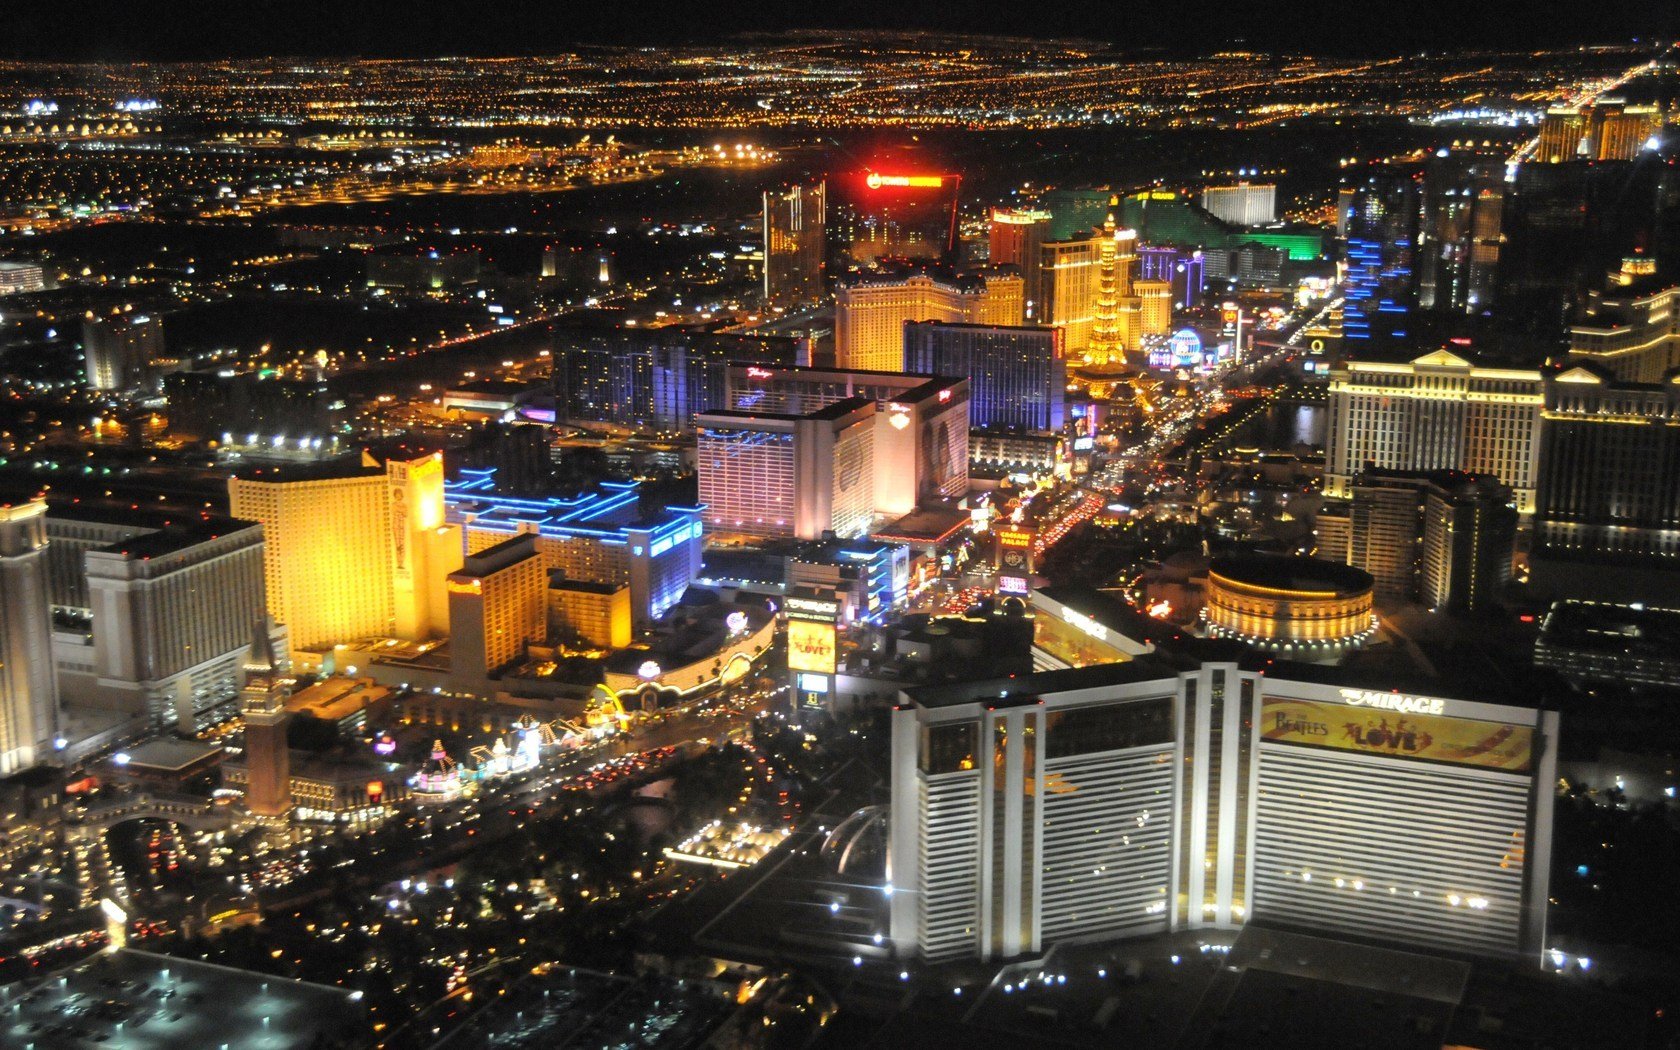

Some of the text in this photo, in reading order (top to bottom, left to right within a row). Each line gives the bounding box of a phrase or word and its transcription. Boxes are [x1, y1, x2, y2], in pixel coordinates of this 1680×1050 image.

[1001, 539, 1029, 547] PALACE
[800, 645, 824, 656] LOVE
[1358, 690, 1444, 715] MIRAGE
[1276, 711, 1329, 736] BEATLES
[1355, 726, 1418, 751] LOVE
